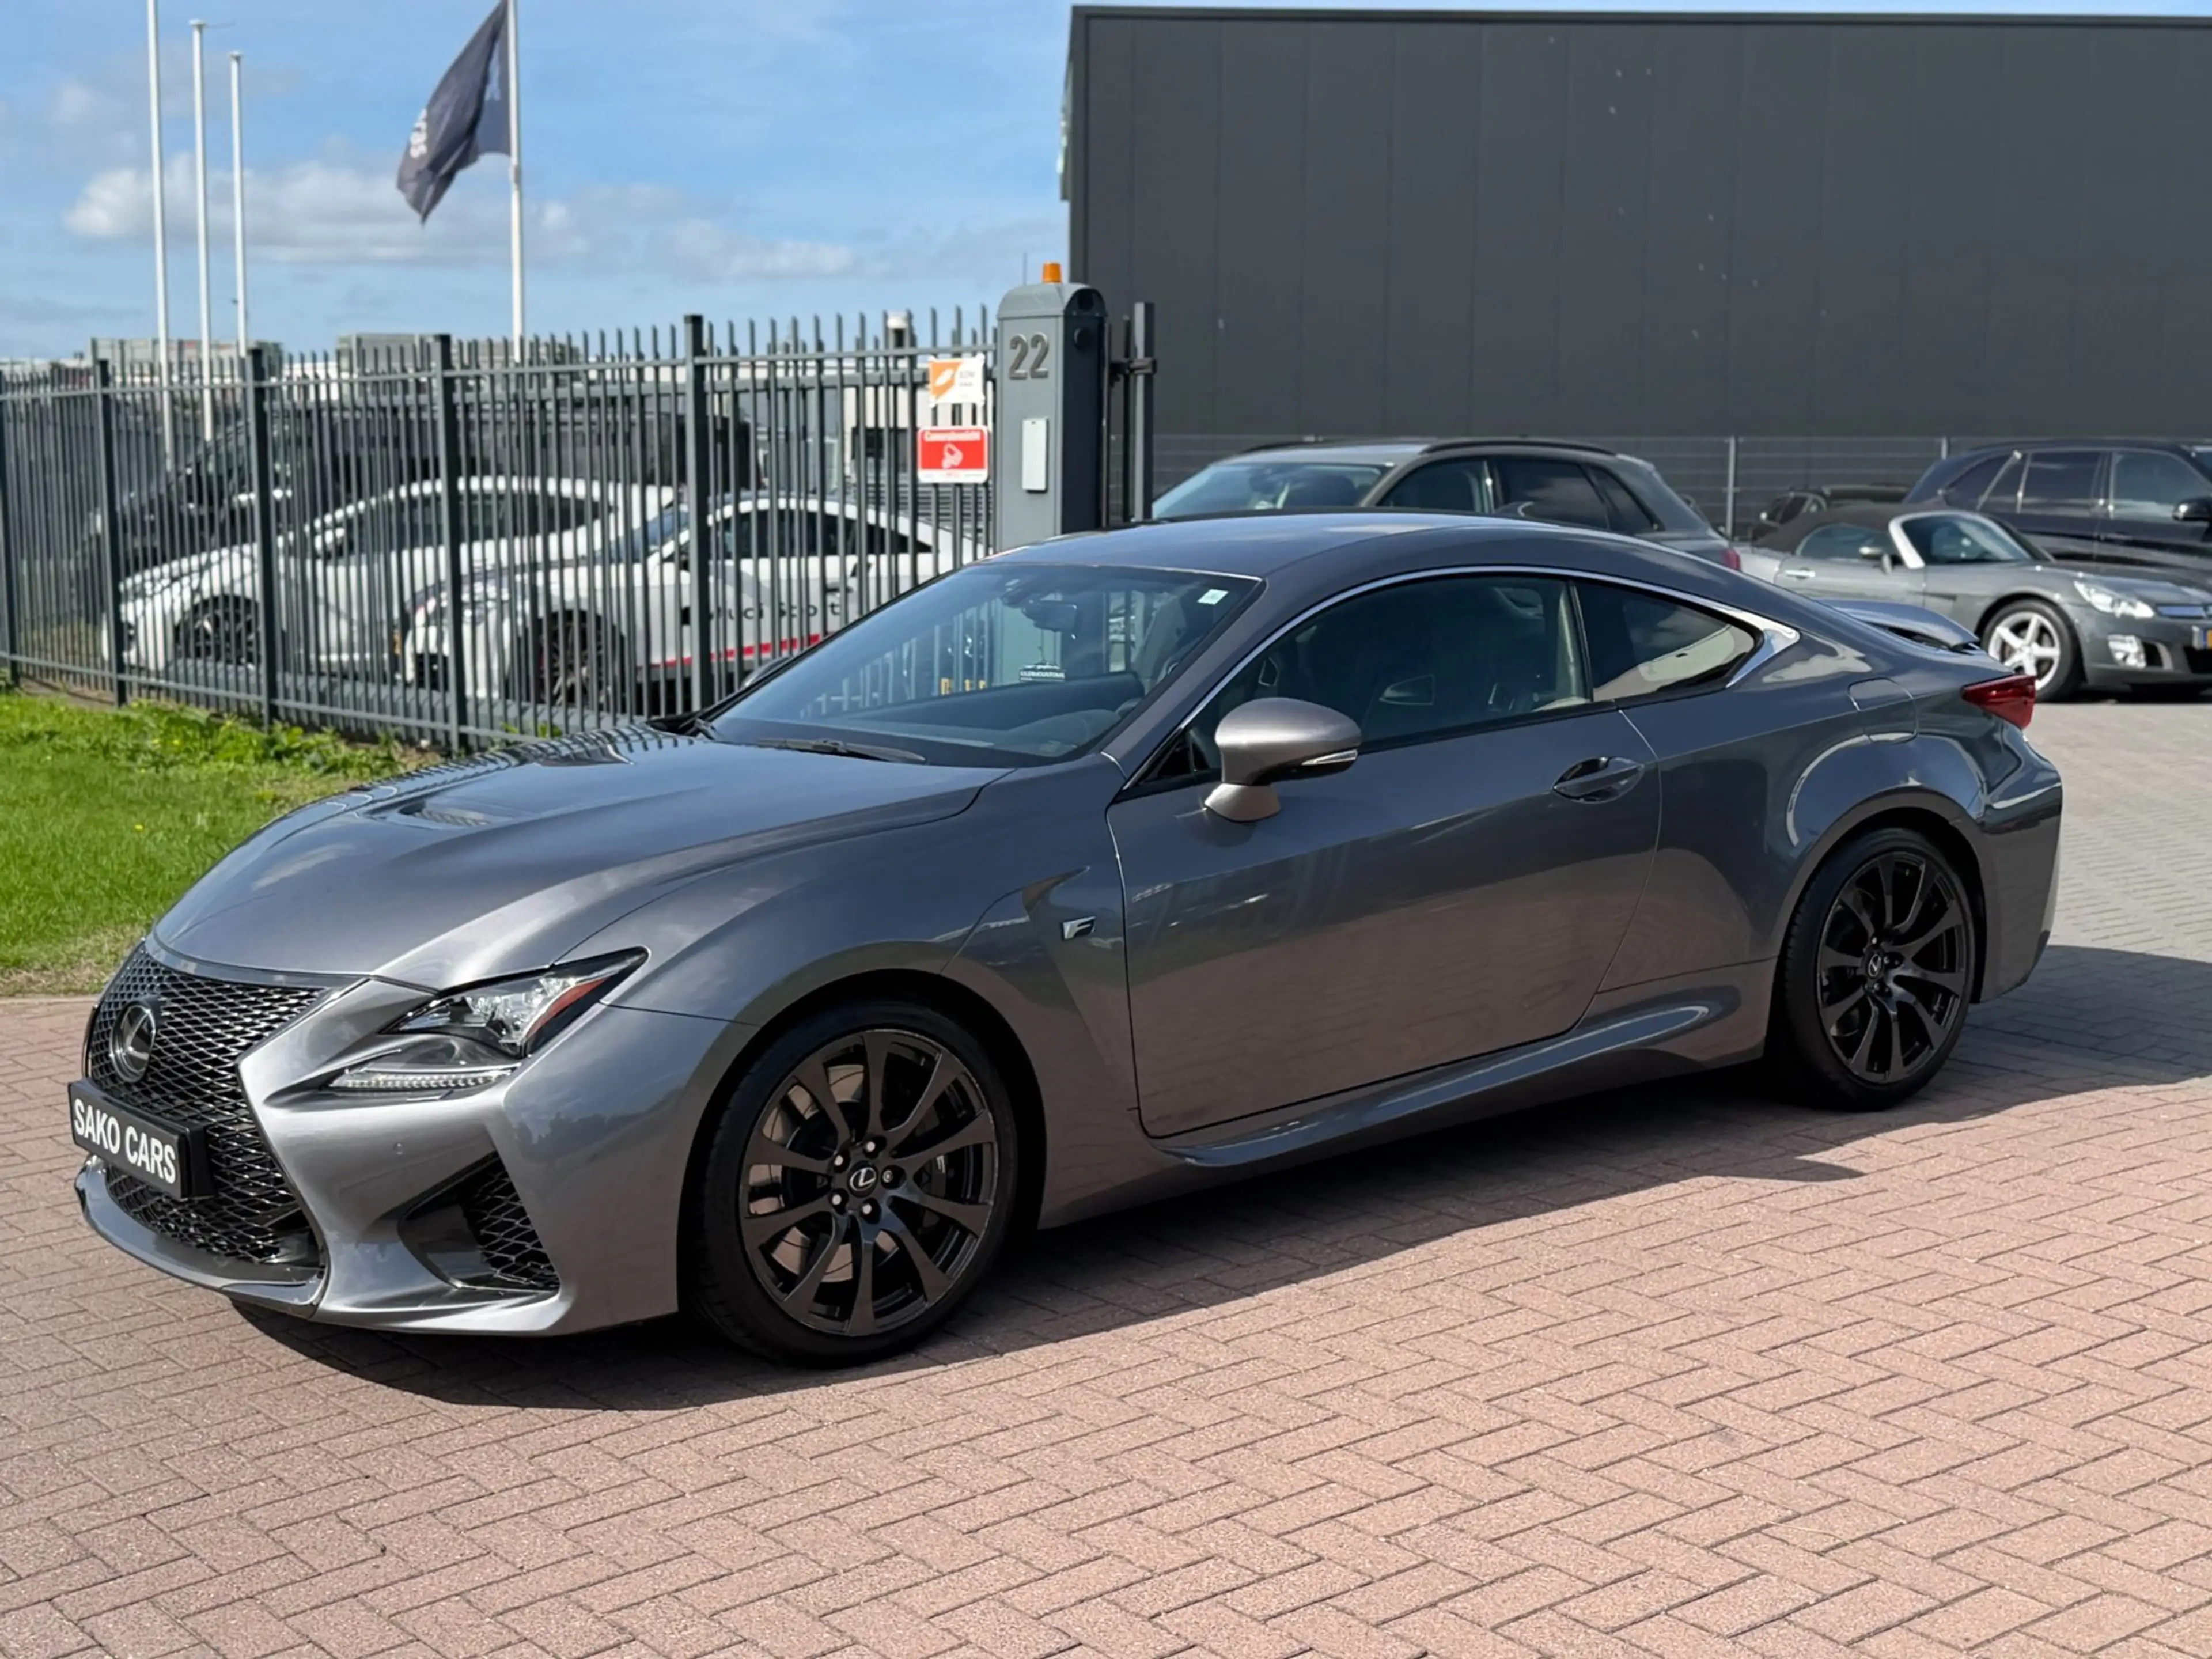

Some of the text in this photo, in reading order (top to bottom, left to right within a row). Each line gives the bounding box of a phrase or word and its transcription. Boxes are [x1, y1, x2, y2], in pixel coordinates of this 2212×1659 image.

[1009, 332, 1049, 380] 22
[74, 1098, 176, 1184] SAKO CARS
